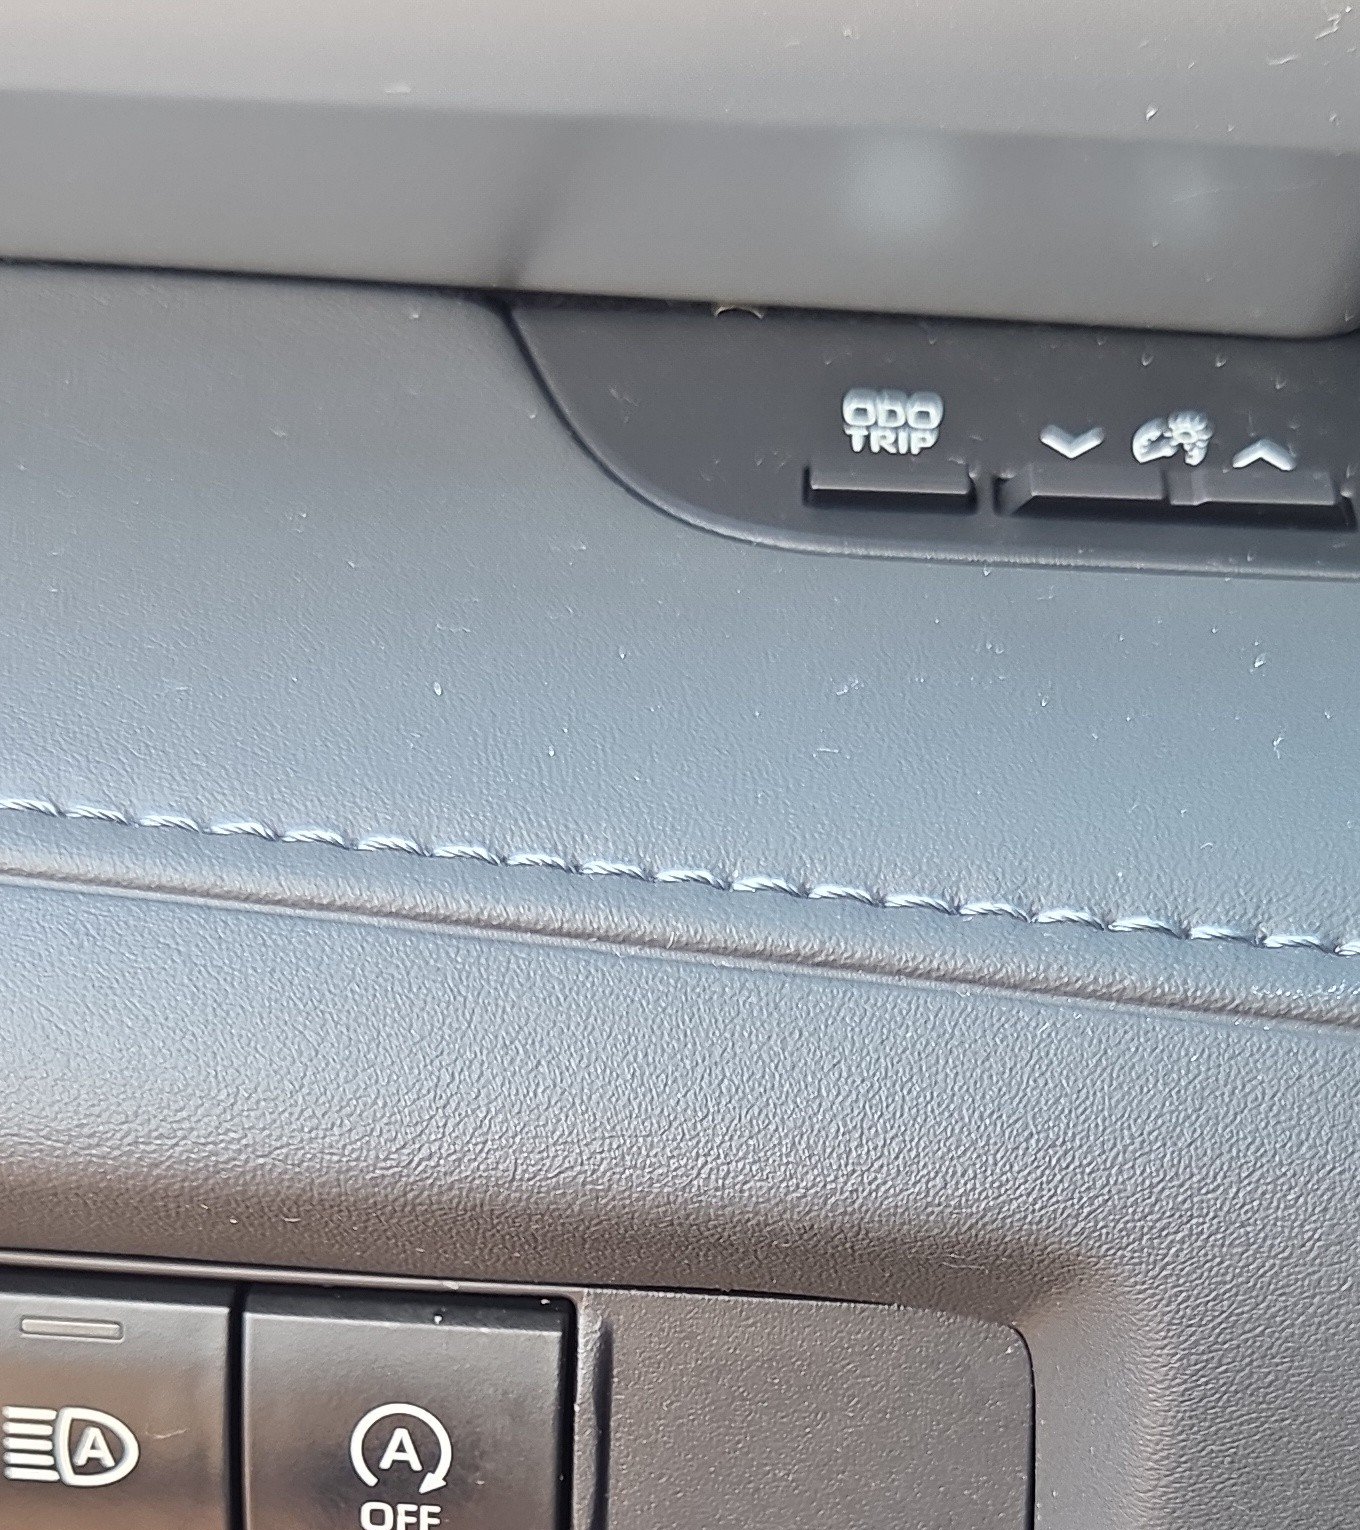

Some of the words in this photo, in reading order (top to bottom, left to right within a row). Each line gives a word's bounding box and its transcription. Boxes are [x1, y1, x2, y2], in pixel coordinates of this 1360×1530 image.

[842, 387, 944, 429] ODO
[843, 424, 940, 455] TRIP
[378, 1428, 423, 1472] A
